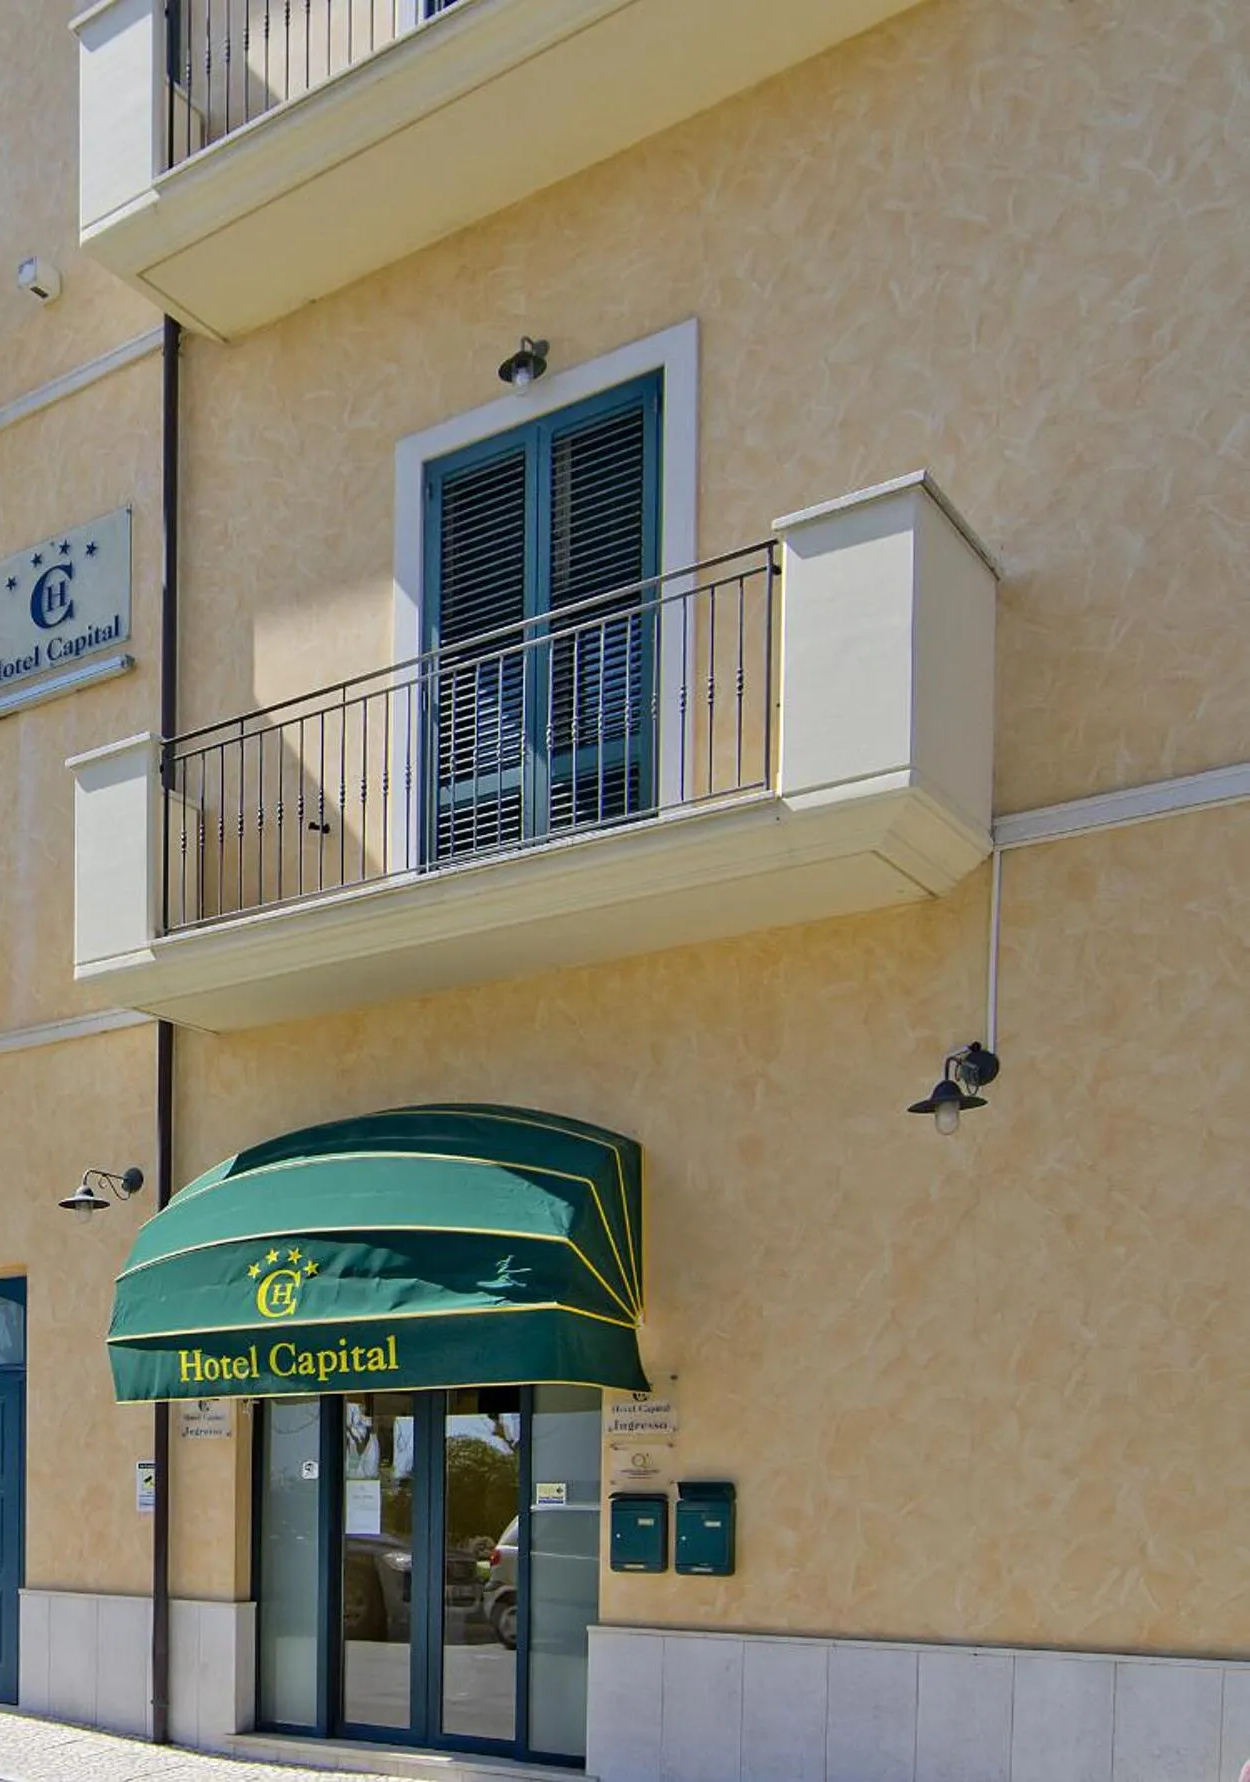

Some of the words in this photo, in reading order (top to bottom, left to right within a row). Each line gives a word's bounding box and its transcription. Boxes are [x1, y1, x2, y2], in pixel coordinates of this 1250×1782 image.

[47, 614, 121, 661] Capital
[178, 1345, 259, 1383] Hotel
[268, 1335, 400, 1381] Capital
